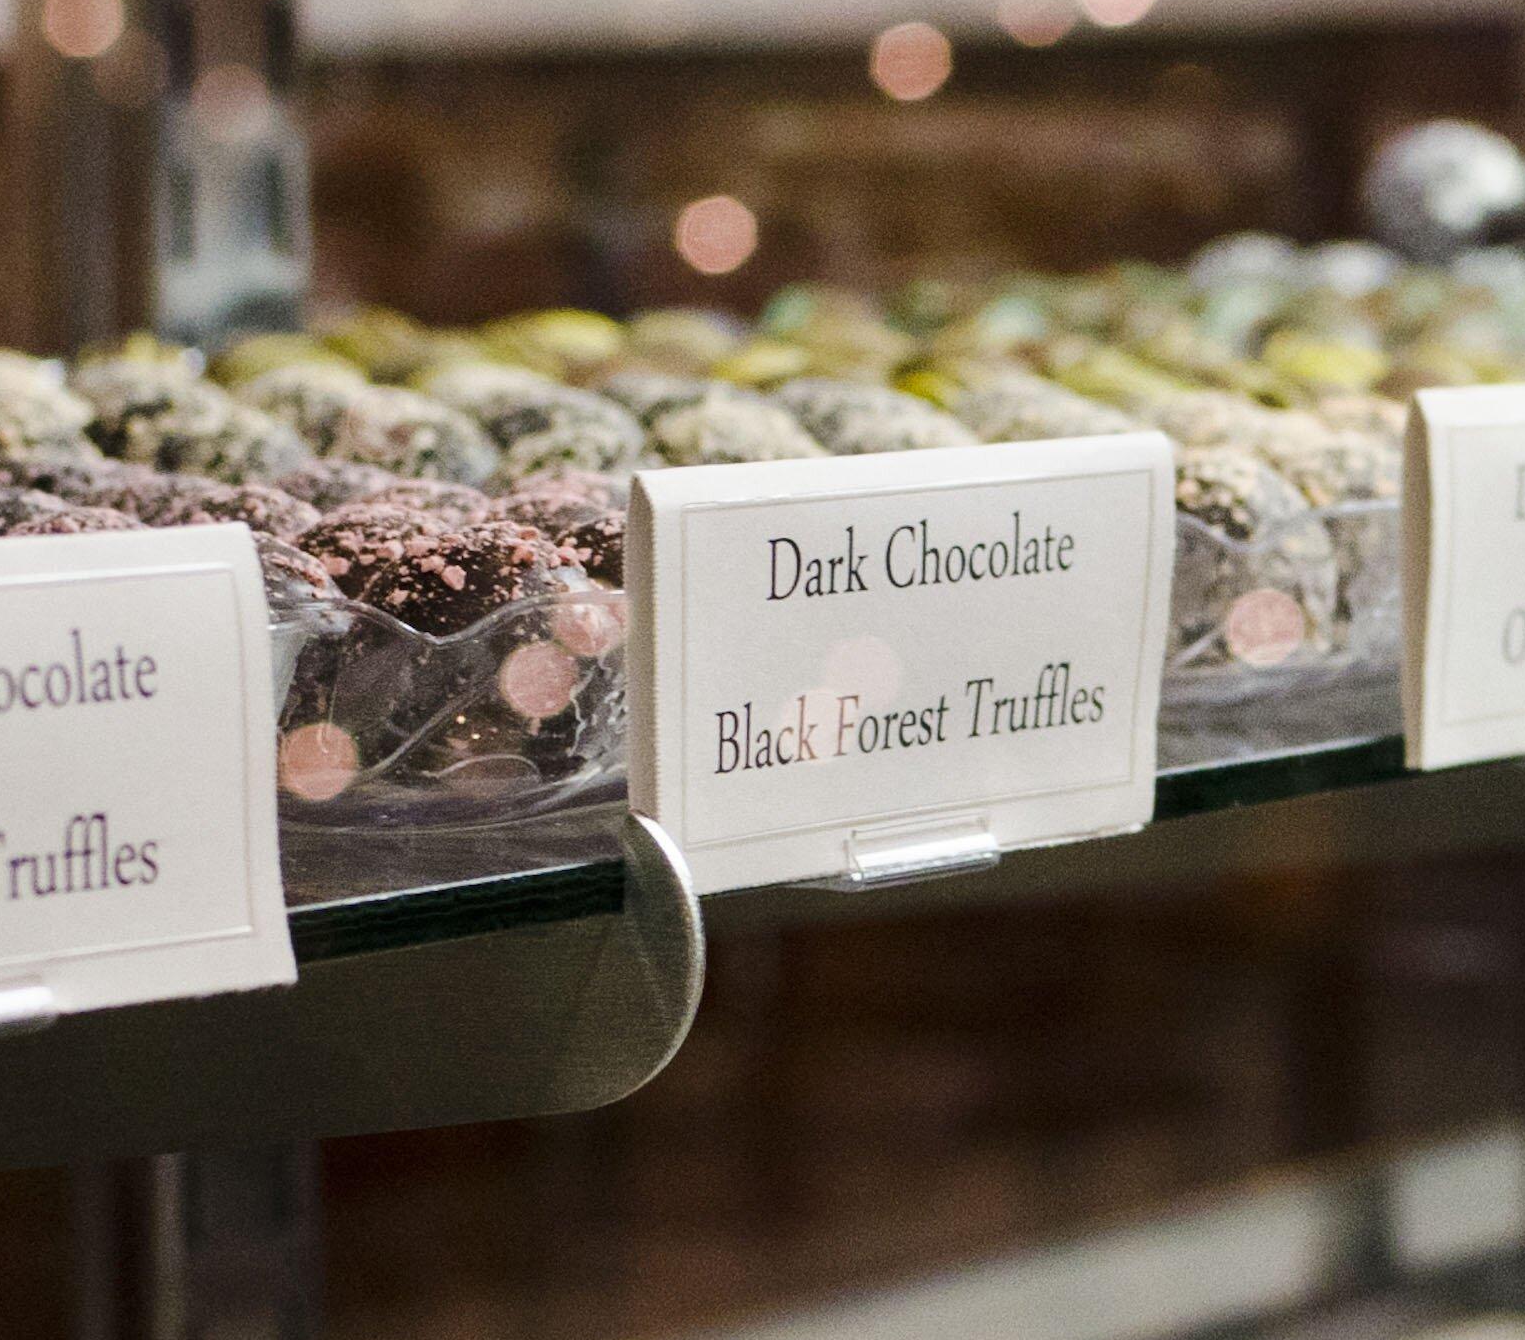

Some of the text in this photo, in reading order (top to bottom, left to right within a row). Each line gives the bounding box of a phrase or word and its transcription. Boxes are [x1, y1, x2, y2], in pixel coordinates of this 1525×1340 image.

[766, 511, 1075, 602] Dark Chocolate
[714, 662, 1106, 775] Black Forest Truffles
